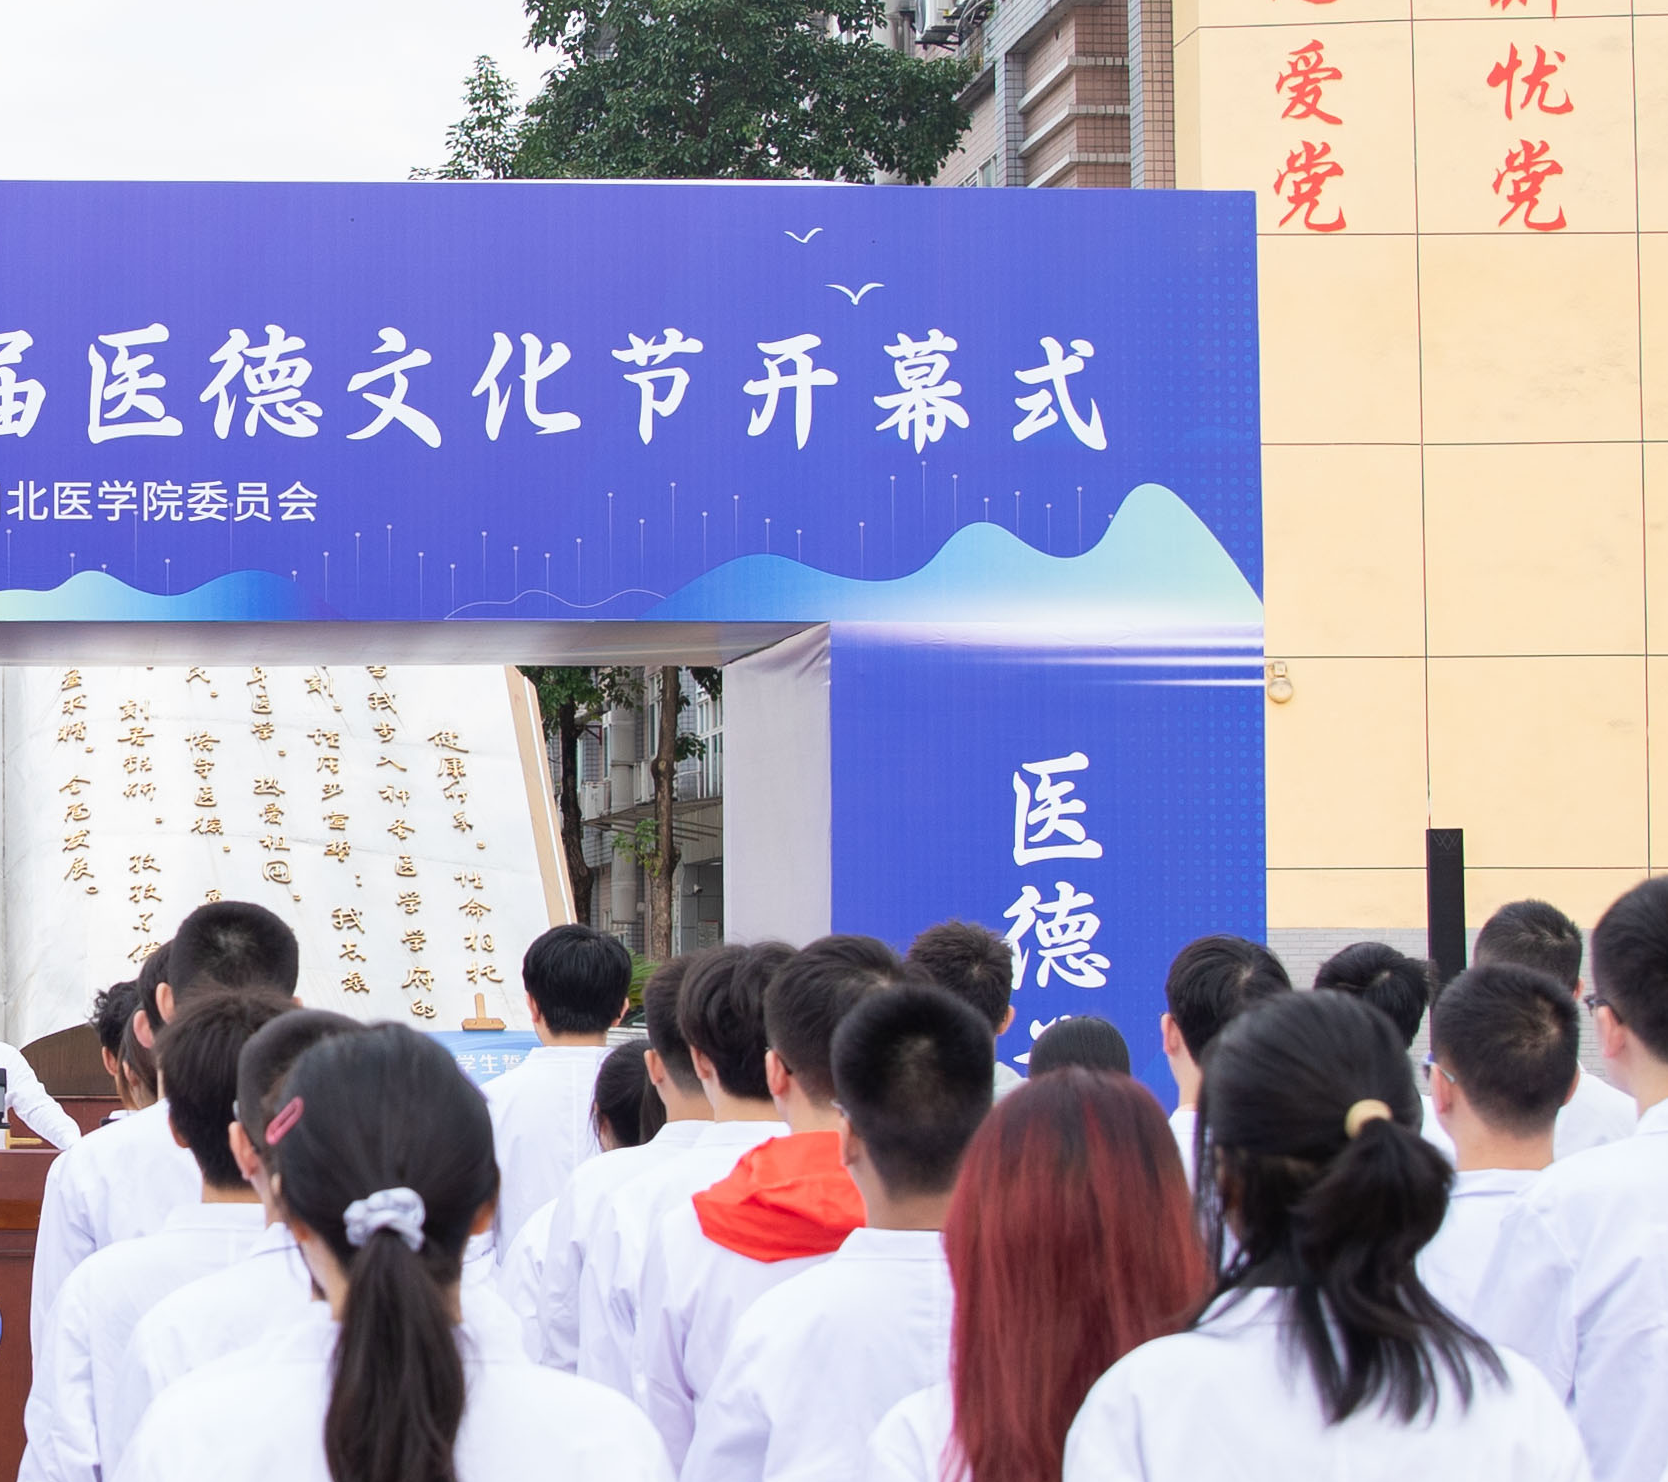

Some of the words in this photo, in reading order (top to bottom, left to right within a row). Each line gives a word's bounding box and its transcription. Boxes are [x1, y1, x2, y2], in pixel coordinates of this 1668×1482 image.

[1002, 751, 1111, 1067] 医德
[455, 1053, 530, 1074] 学生誓
